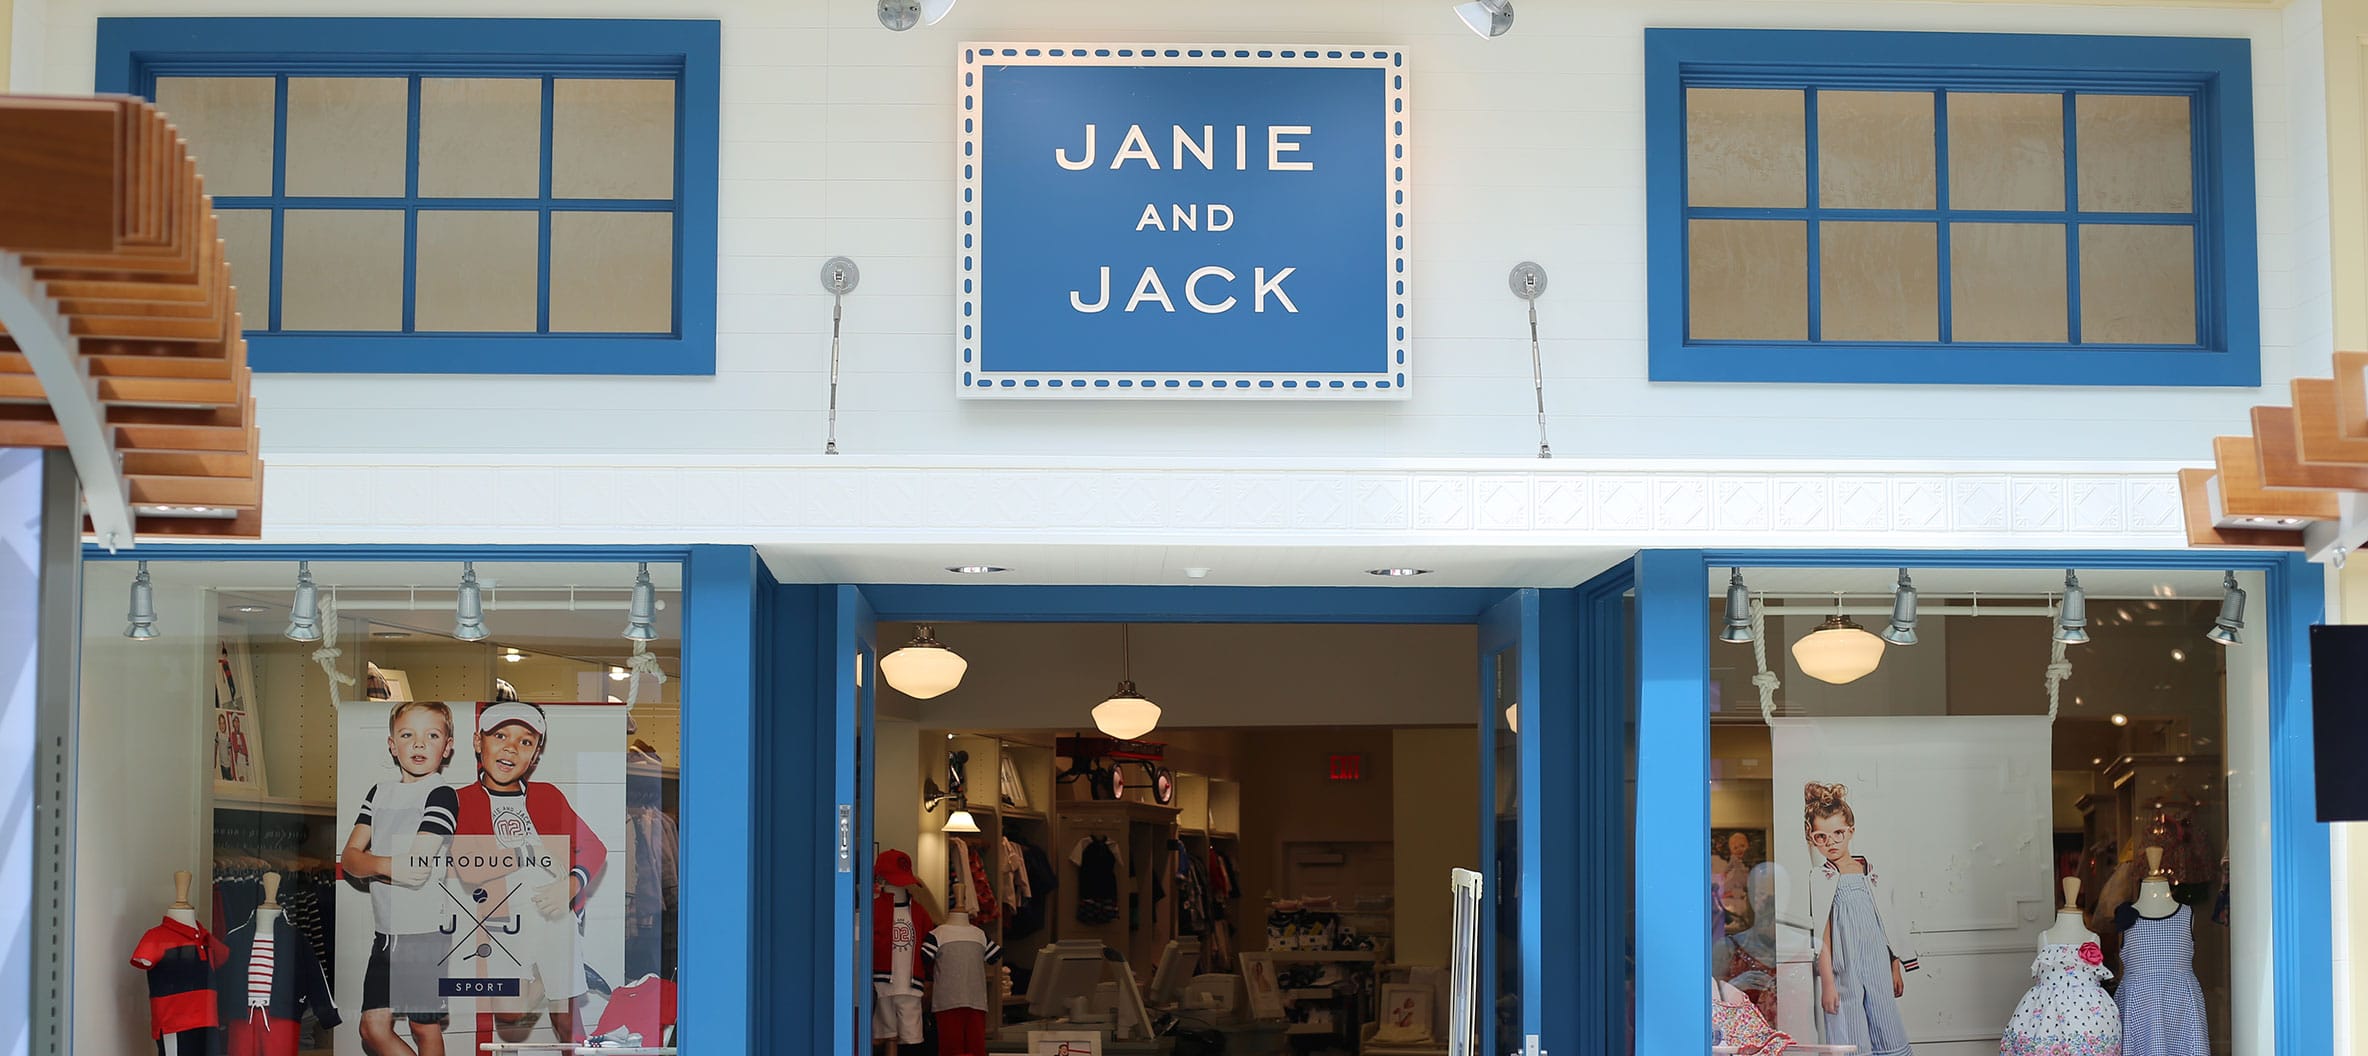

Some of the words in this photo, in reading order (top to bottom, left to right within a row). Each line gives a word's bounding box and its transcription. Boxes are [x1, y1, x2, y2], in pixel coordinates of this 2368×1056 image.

[1055, 124, 1314, 171] JANIE
[1135, 203, 1235, 232] AND
[1069, 265, 1299, 314] JACK
[1330, 755, 1361, 780] EXIT
[410, 855, 552, 868] INTRODUCING
[439, 914, 457, 935] J
[503, 914, 520, 935] J
[893, 926, 910, 942] 02
[455, 982, 504, 992] SPORT
